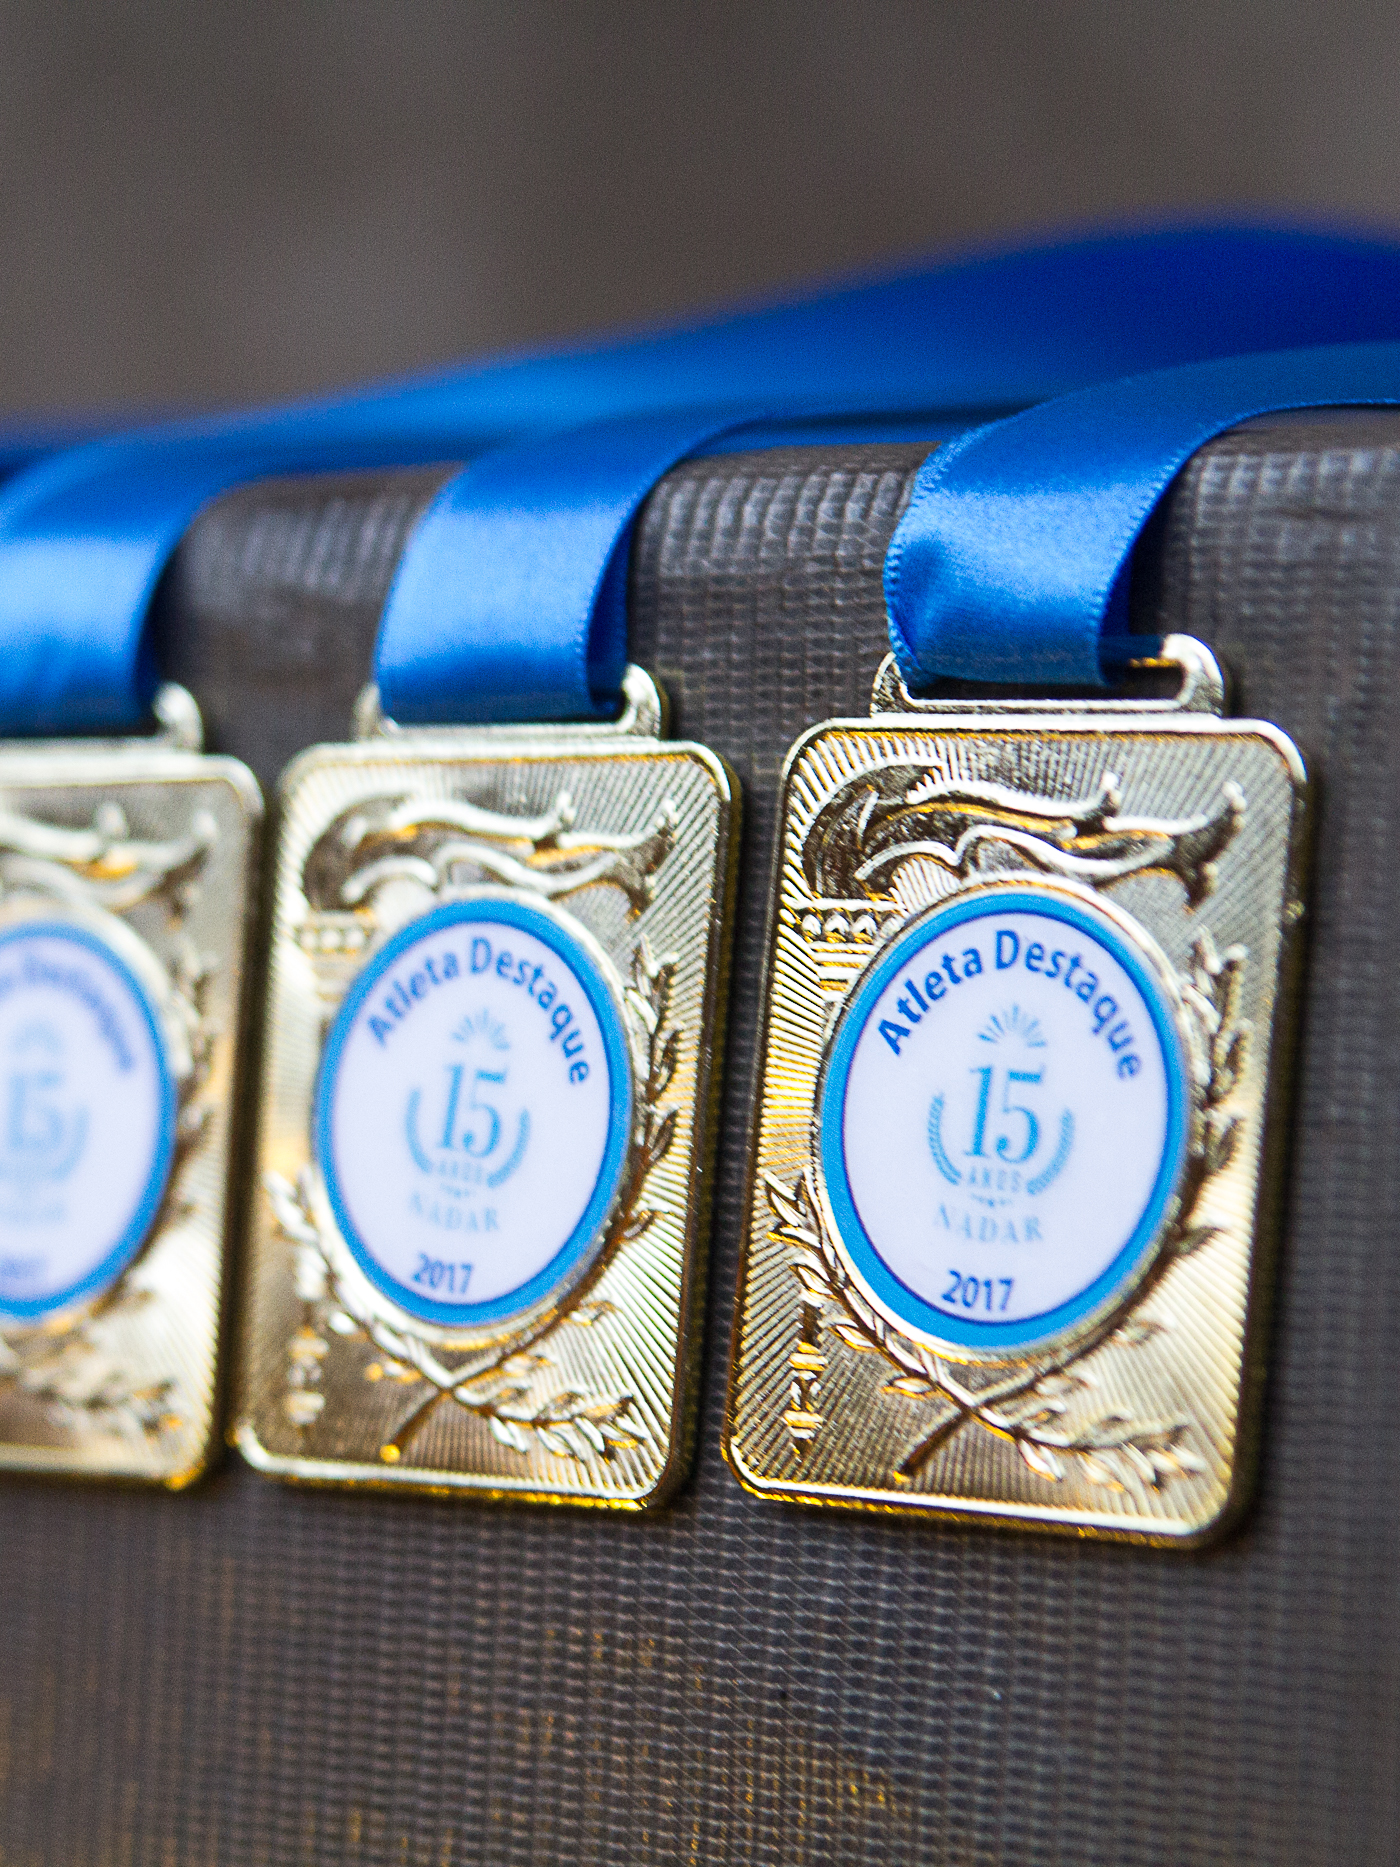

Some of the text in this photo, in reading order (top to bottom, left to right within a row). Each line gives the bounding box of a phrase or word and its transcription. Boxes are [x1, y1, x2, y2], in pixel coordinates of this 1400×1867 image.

[367, 935, 591, 1086] Atleta Destaque
[876, 928, 1143, 1081] Atleta Destaque
[437, 1062, 509, 1159] 15
[963, 1062, 1047, 1165] 15
[932, 1201, 1044, 1244] NADAR
[409, 1252, 475, 1296] 2017
[941, 1268, 1015, 1313] 2017
